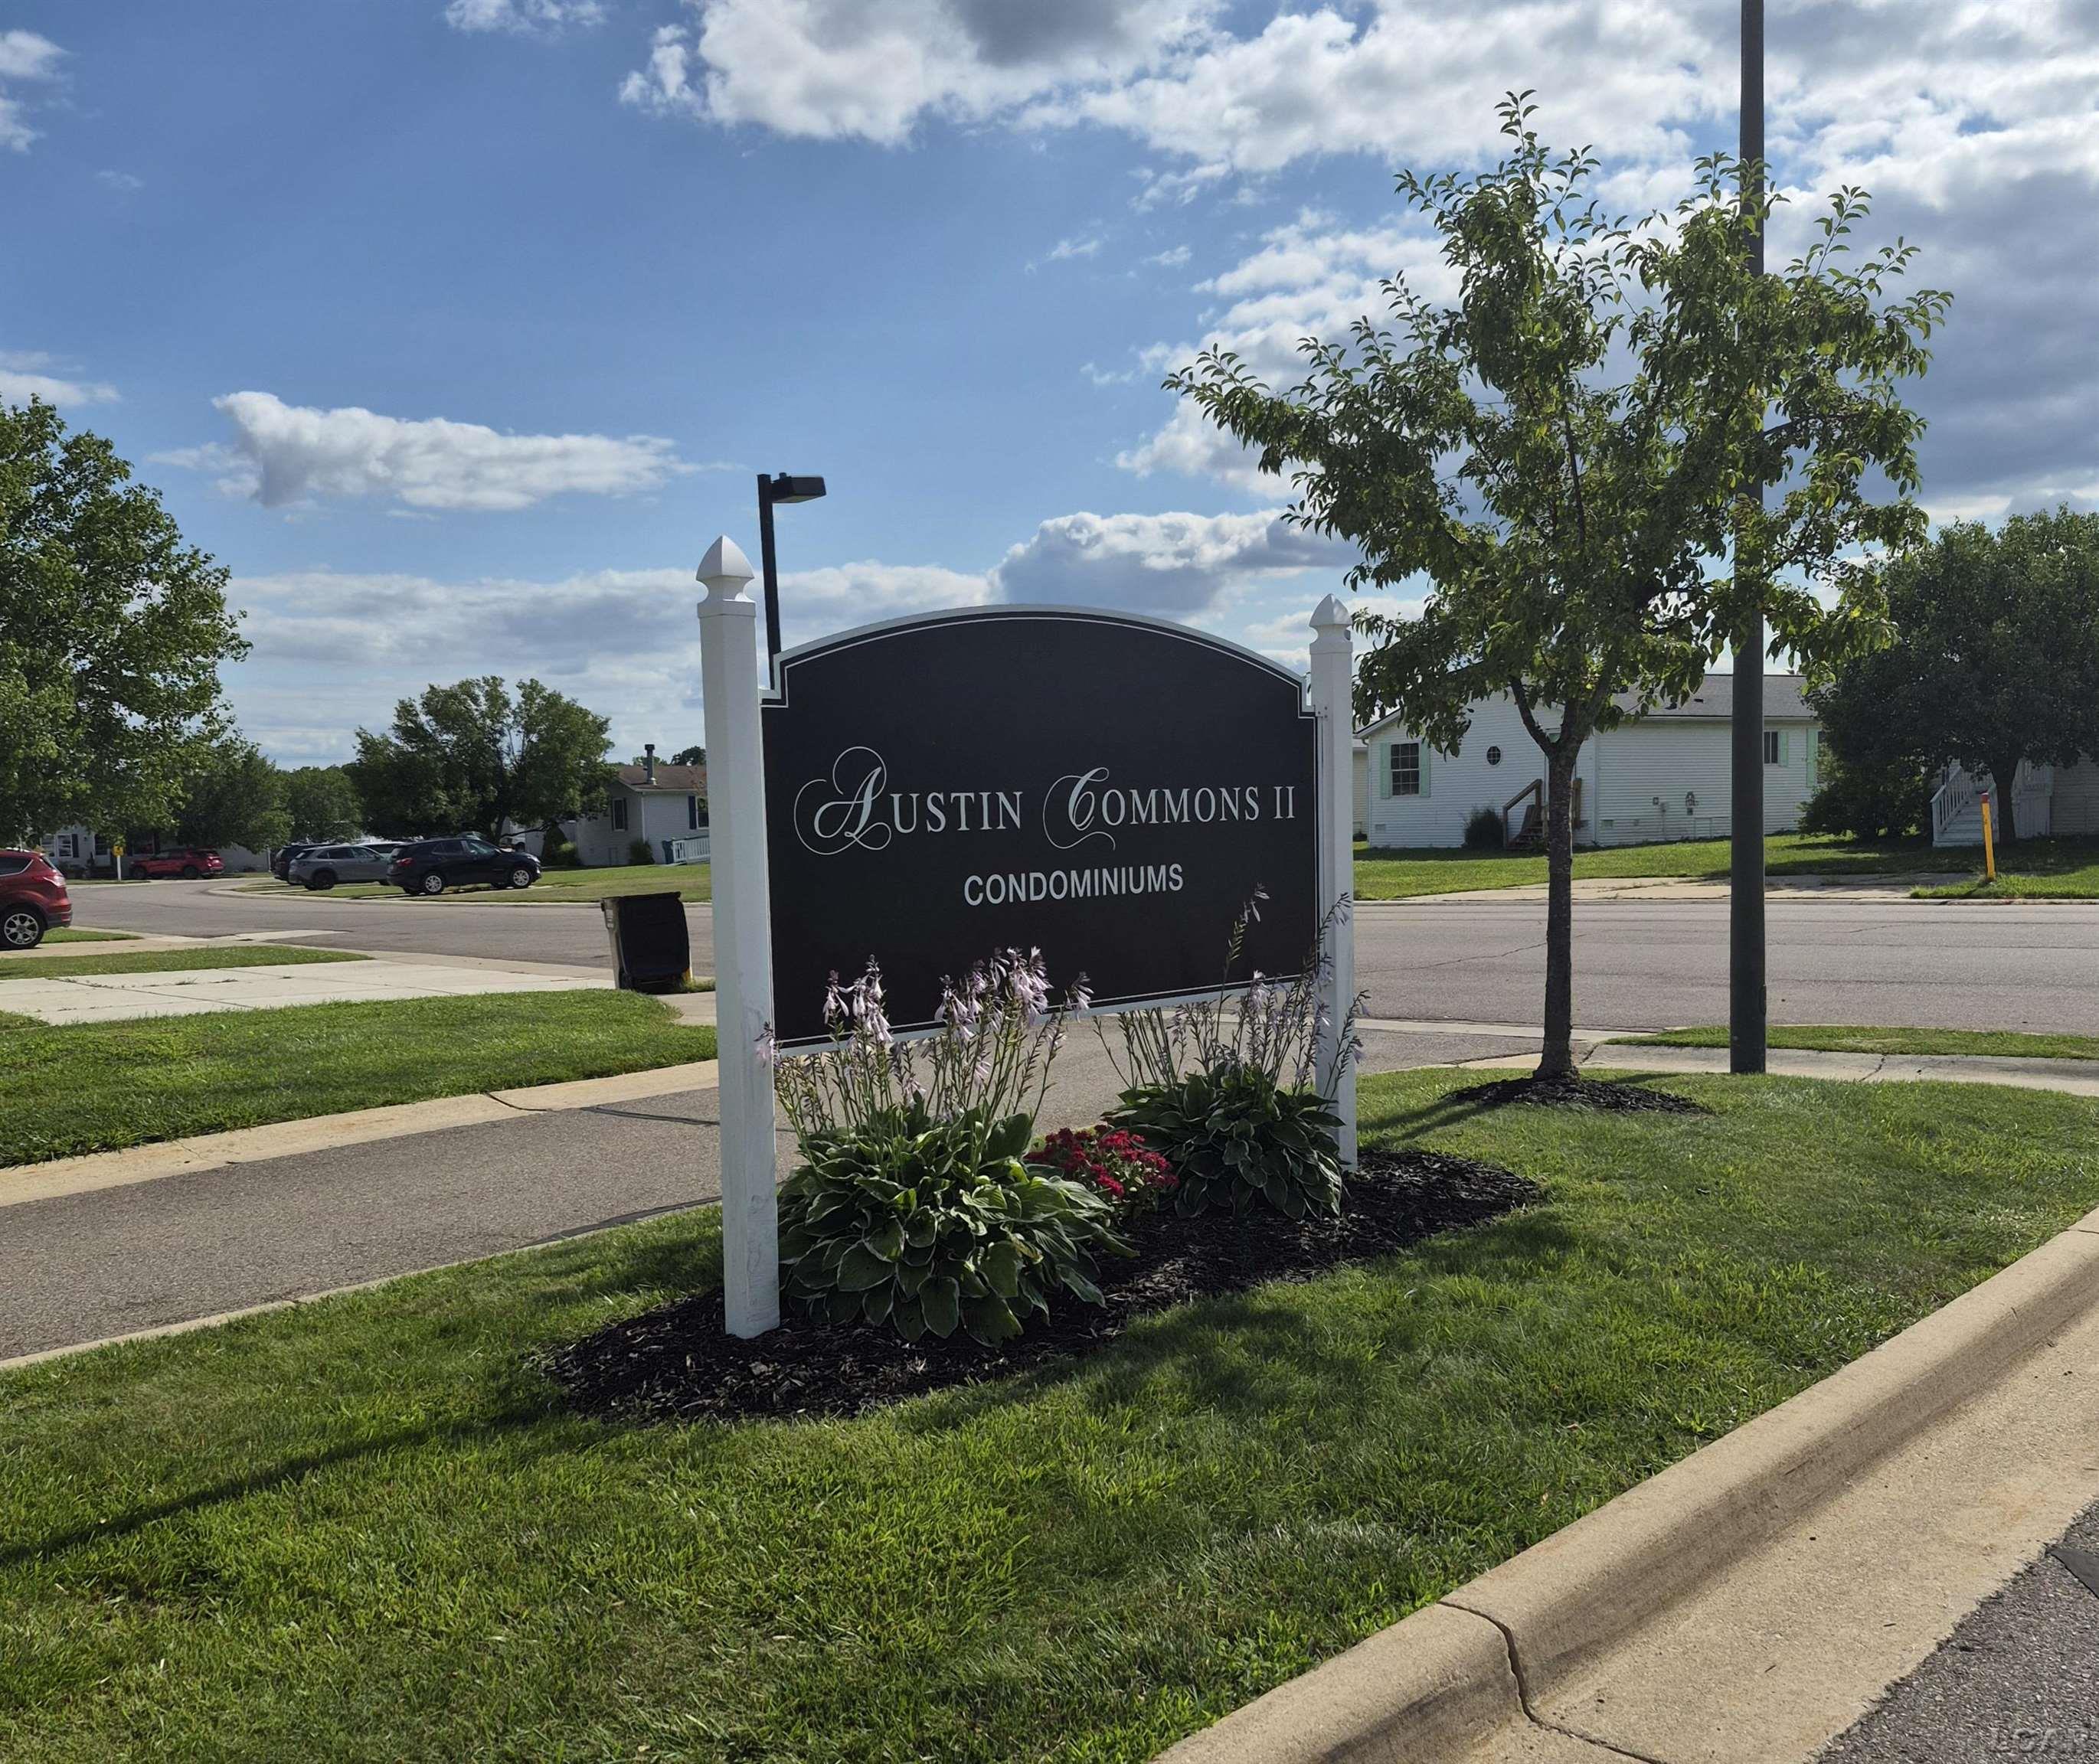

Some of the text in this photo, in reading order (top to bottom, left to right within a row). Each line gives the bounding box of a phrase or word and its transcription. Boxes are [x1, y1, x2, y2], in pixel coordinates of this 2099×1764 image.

[793, 745, 1296, 856] AUSTIN COMMONS II
[963, 862, 1185, 906] CONDOMINIUMS
